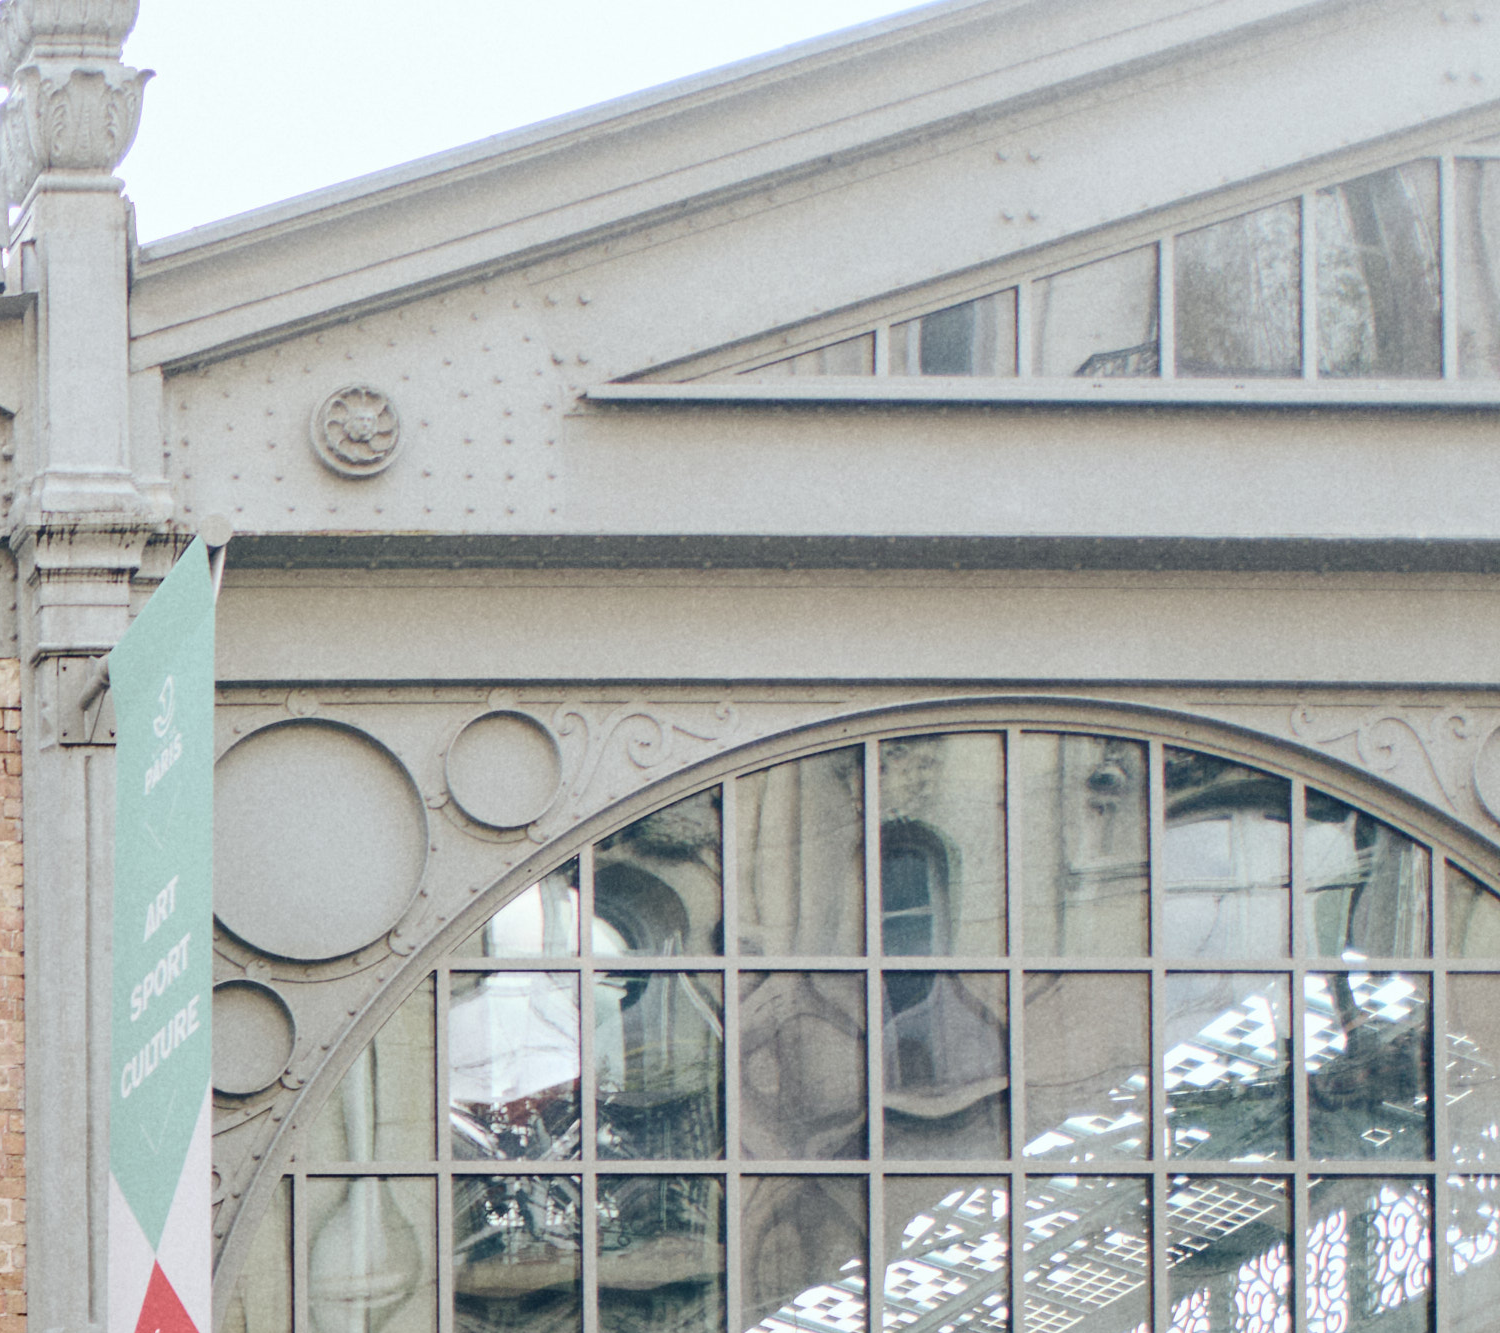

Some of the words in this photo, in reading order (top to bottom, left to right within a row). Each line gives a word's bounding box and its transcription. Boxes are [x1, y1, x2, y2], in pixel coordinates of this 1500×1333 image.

[144, 733, 182, 795] PARIS
[143, 874, 179, 943] ART
[130, 933, 191, 1022] SPORT
[120, 995, 200, 1099] CULTURE
